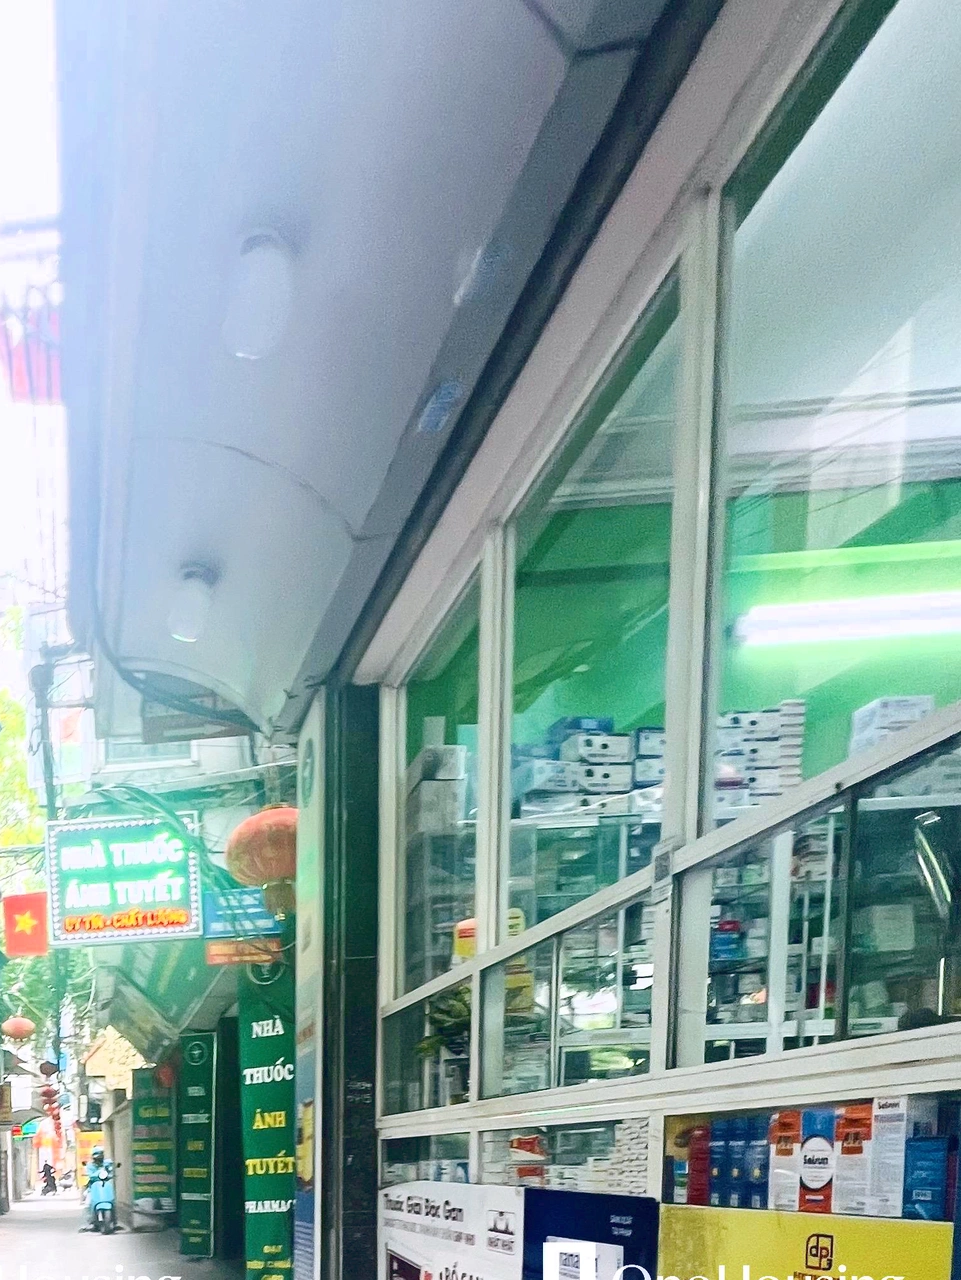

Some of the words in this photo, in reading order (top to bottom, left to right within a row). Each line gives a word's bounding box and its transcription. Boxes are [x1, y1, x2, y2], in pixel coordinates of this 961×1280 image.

[60, 838, 107, 871] NHÀ
[109, 832, 185, 867] THUỐC
[113, 869, 186, 905] TUYẾT
[251, 1015, 285, 1039] NHÀ
[242, 1057, 294, 1085] THUỐC
[252, 1108, 287, 1130] ÁNH
[245, 1149, 295, 1176] TUYẾT
